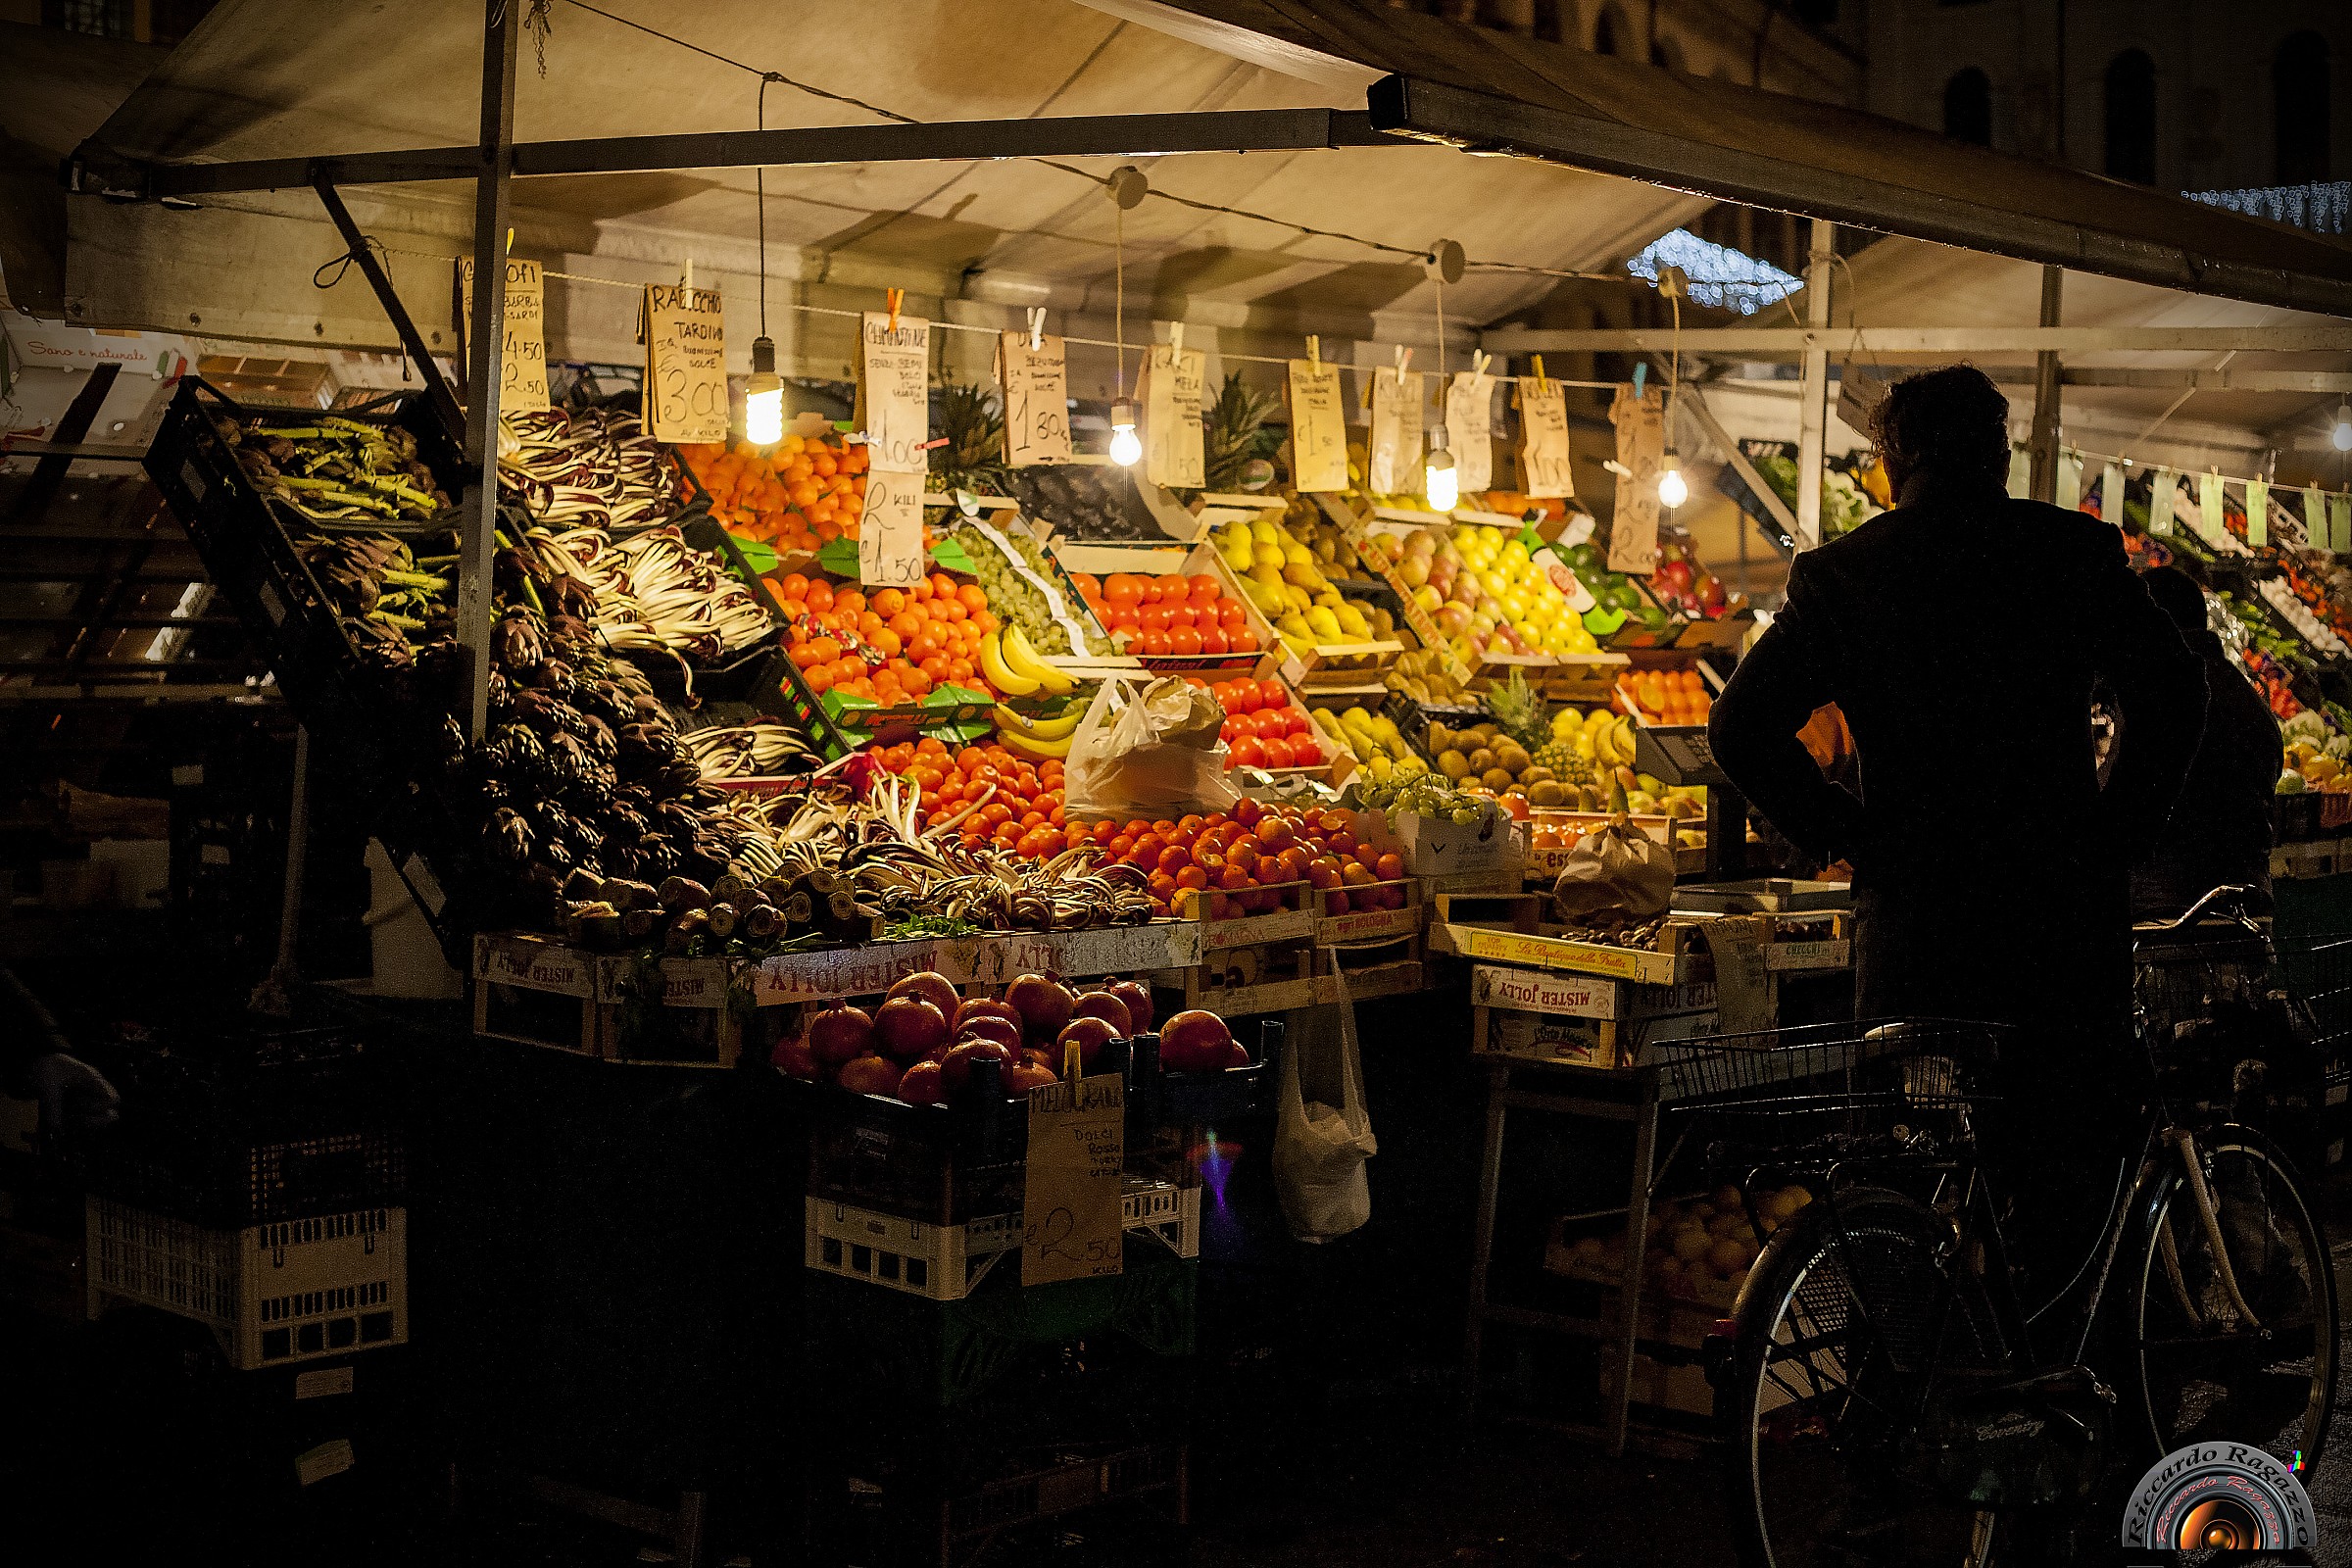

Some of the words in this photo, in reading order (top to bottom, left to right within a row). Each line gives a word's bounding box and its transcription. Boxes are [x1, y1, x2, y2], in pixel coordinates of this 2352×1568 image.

[27, 341, 73, 357] Sano
[89, 347, 147, 362] naturale
[768, 963, 841, 993] JOLLY
[1498, 982, 1540, 1004] JOLLY
[1541, 991, 1592, 1006] MISTER
